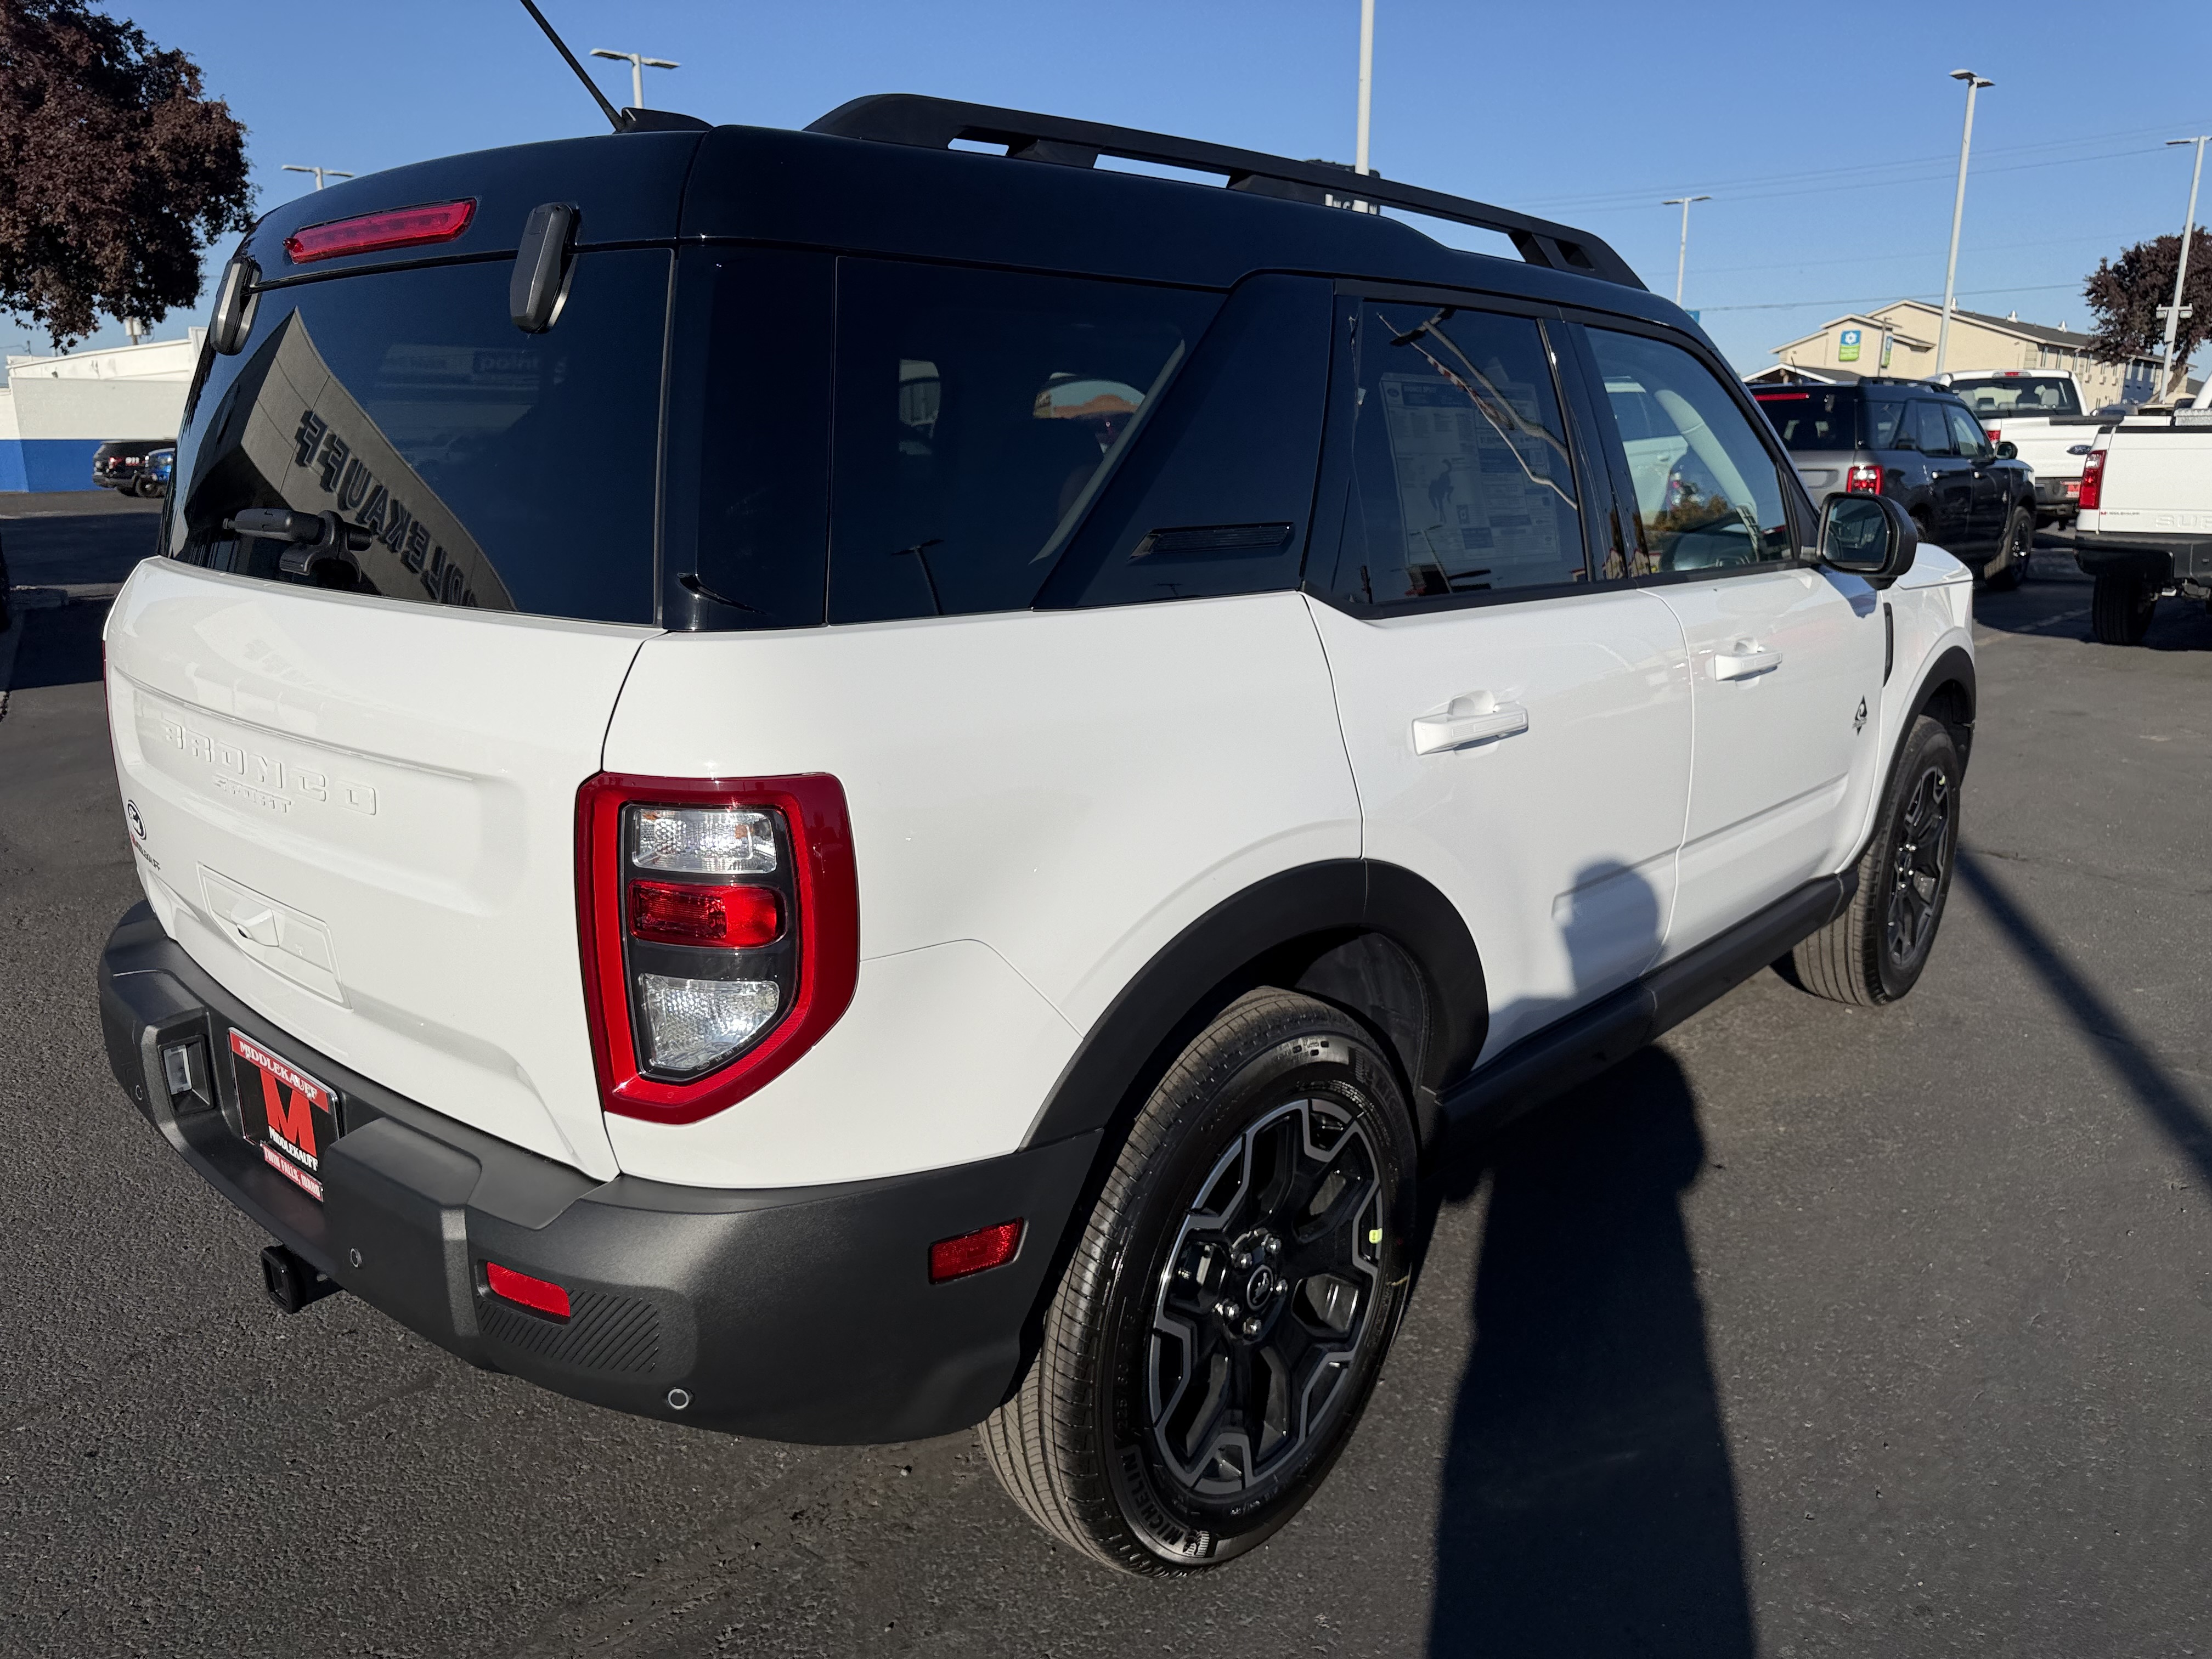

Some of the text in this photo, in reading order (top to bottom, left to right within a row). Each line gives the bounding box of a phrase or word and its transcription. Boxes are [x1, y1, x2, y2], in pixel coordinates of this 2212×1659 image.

[162, 719, 377, 816] BRONCO
[213, 773, 292, 813] SPORT
[239, 1041, 318, 1099] MIDDLEKAUFF
[261, 1069, 317, 1158] M
[263, 1146, 280, 1169] TWIN
[301, 1171, 320, 1198] IDAHO
[269, 1126, 319, 1171] MIDDLEKAUFF
[1122, 1452, 1184, 1546] MICHELIN
